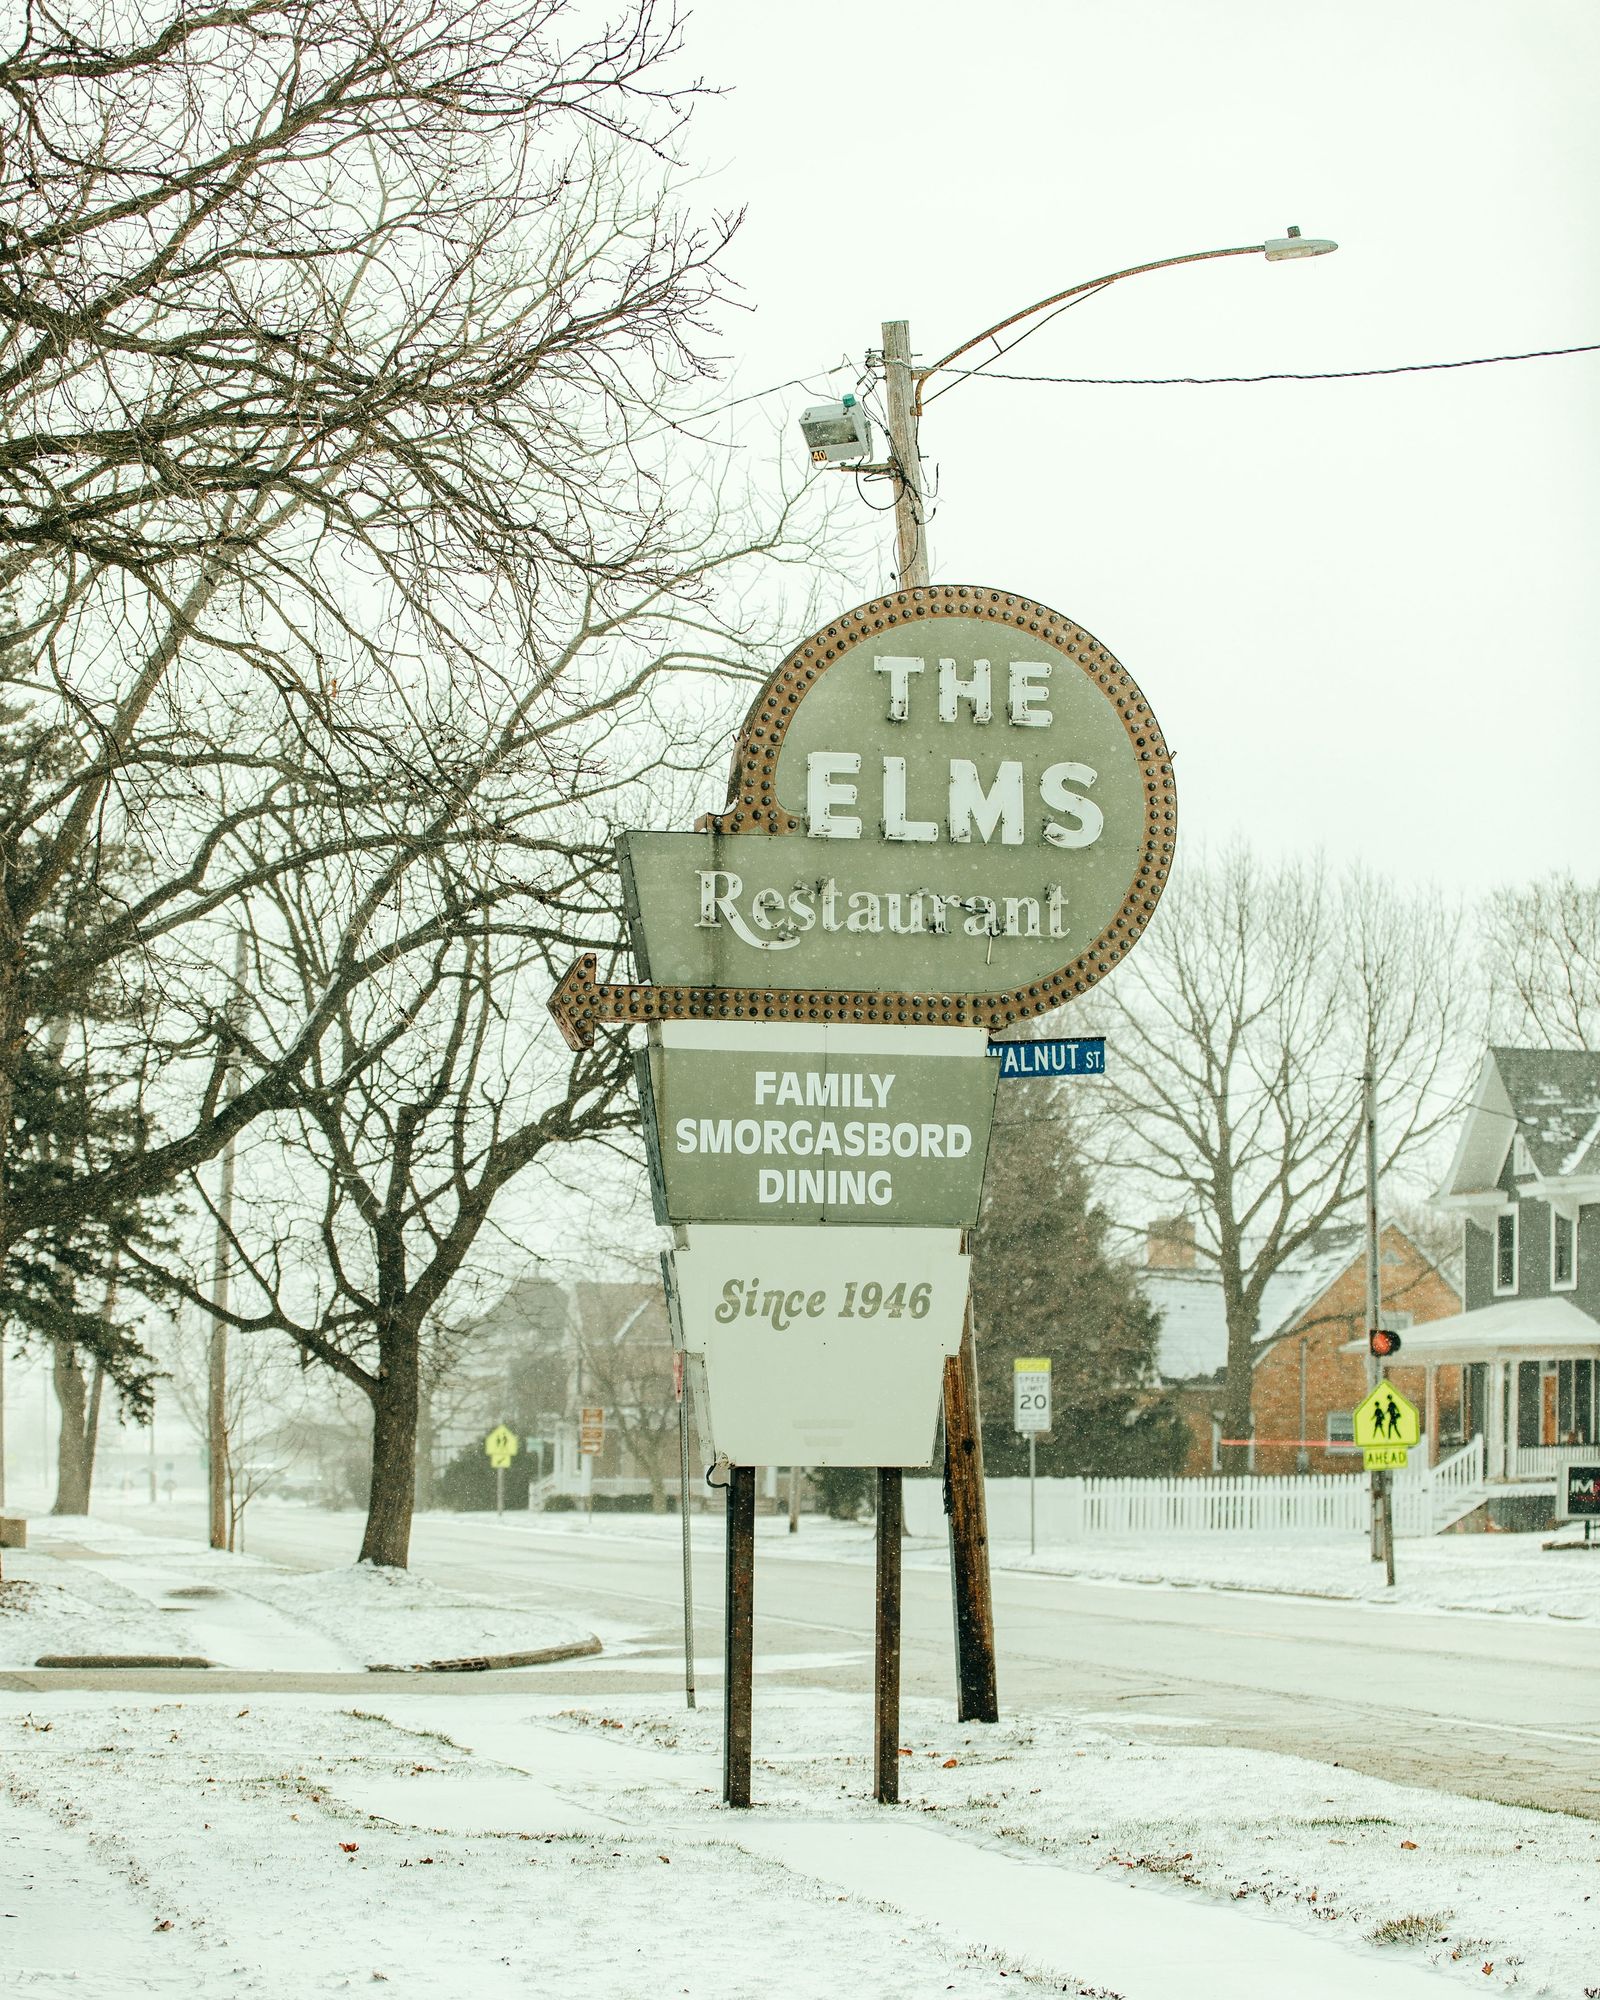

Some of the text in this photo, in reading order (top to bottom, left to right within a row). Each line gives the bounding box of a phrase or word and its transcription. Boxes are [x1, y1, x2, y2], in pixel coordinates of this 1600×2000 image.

[813, 450, 826, 461] 40
[873, 655, 1054, 727] THE
[805, 751, 1105, 849] ELMS
[694, 869, 1071, 951] Restaurant
[1085, 1051, 1104, 1069] ST.
[755, 1071, 896, 1108] FAMILY
[675, 1118, 972, 1158] SMORGASBORD
[758, 1169, 893, 1206] DINING
[714, 1278, 933, 1332] Since 1946
[1019, 1394, 1047, 1410] 20
[1366, 1451, 1407, 1465] AHEAD
